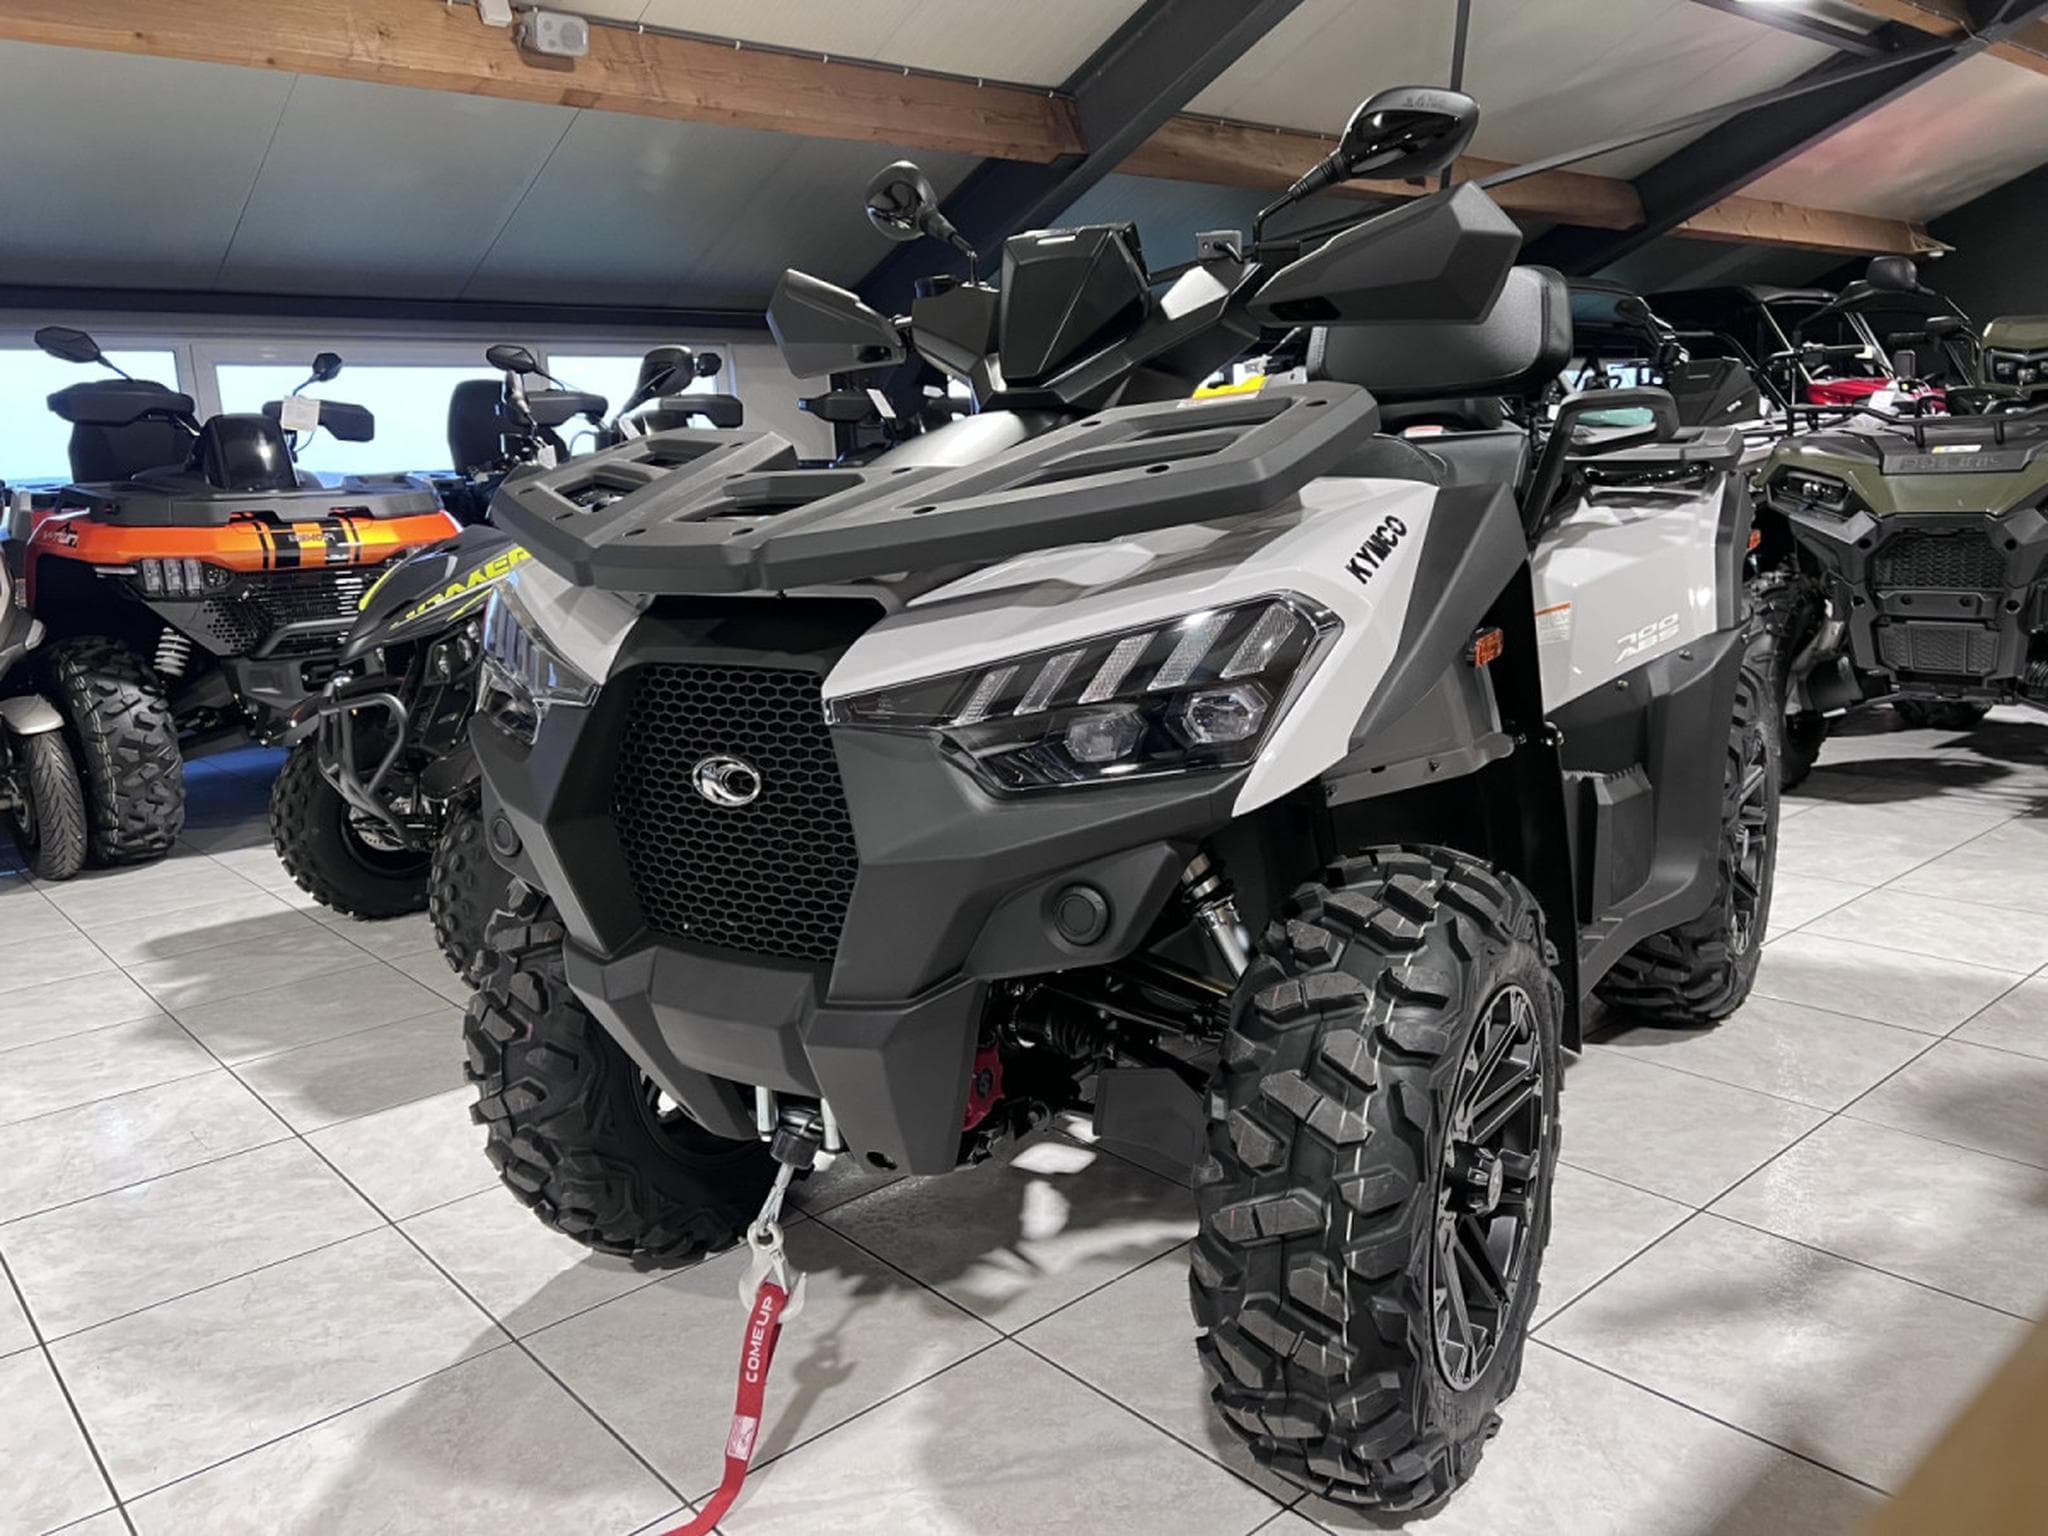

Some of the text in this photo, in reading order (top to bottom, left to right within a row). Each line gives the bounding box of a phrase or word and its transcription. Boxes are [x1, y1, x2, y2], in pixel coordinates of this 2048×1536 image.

[1345, 515, 1407, 585] KYMCO
[1614, 624, 1680, 664] ABS
[1617, 612, 1679, 645] 700
